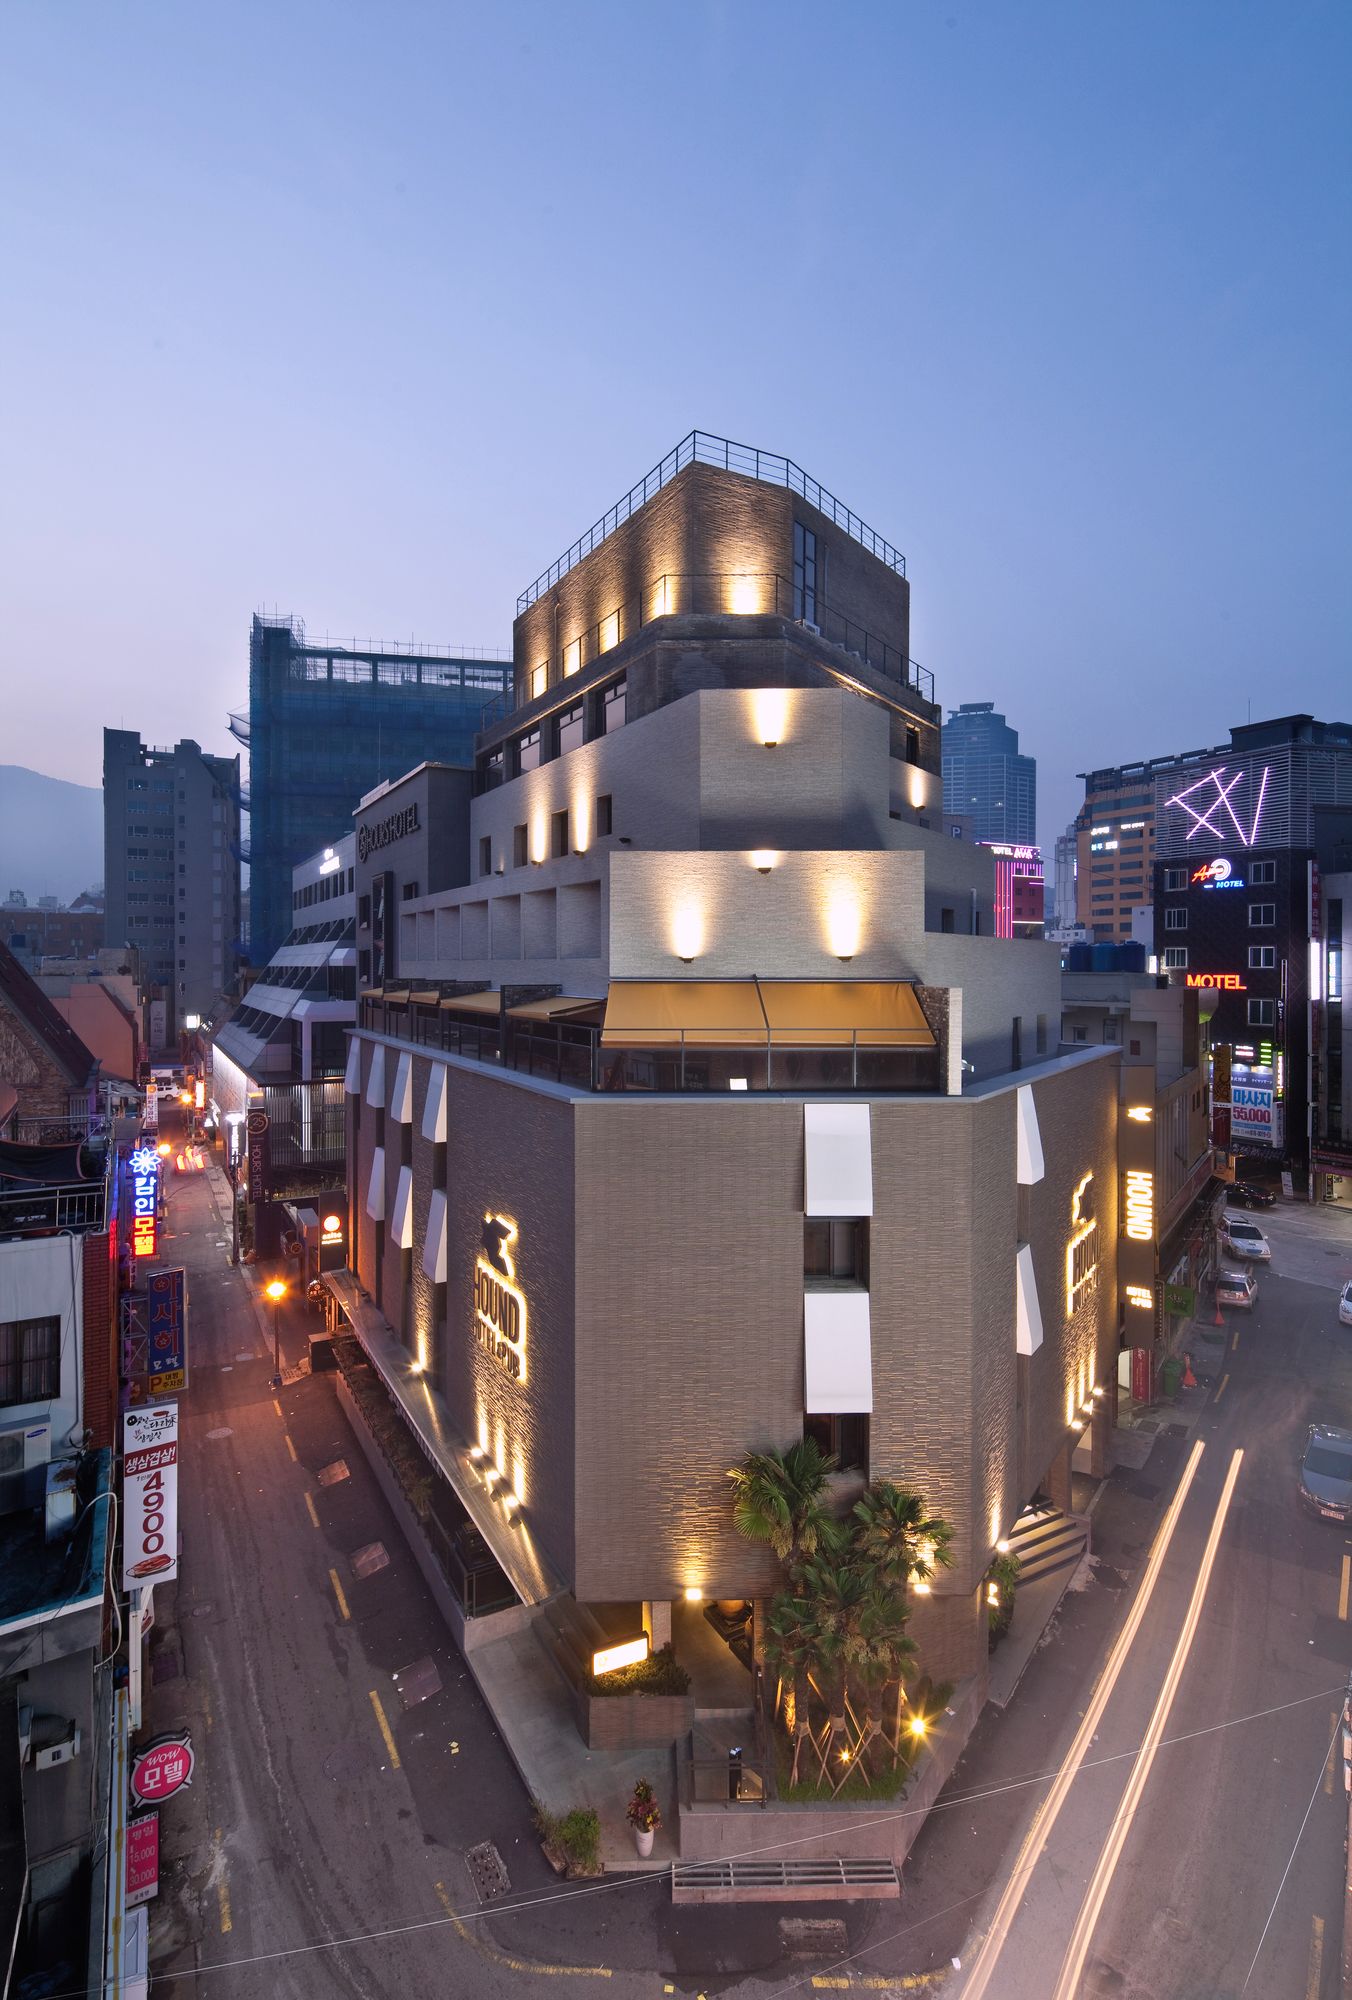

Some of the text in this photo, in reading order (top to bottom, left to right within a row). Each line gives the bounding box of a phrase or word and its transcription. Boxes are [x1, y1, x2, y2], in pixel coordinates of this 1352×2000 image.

[1216, 880, 1244, 888] MOTEL
[1187, 975, 1247, 990] MOTEL
[1233, 1089, 1272, 1108] 마사지
[1233, 1106, 1271, 1123] 55,000
[252, 1144, 262, 1200] HOURS HOTEL
[1127, 1170, 1153, 1240] HOUND
[473, 1265, 520, 1345] HOUND
[1126, 1286, 1152, 1299] HOTEL
[153, 1272, 181, 1356] 아사히
[474, 1315, 496, 1357] HOTEL
[151, 1376, 162, 1393] P
[126, 1446, 176, 1473] 생삼겹살!
[142, 1469, 165, 1555] 4900
[142, 1759, 183, 1793] 모텔
